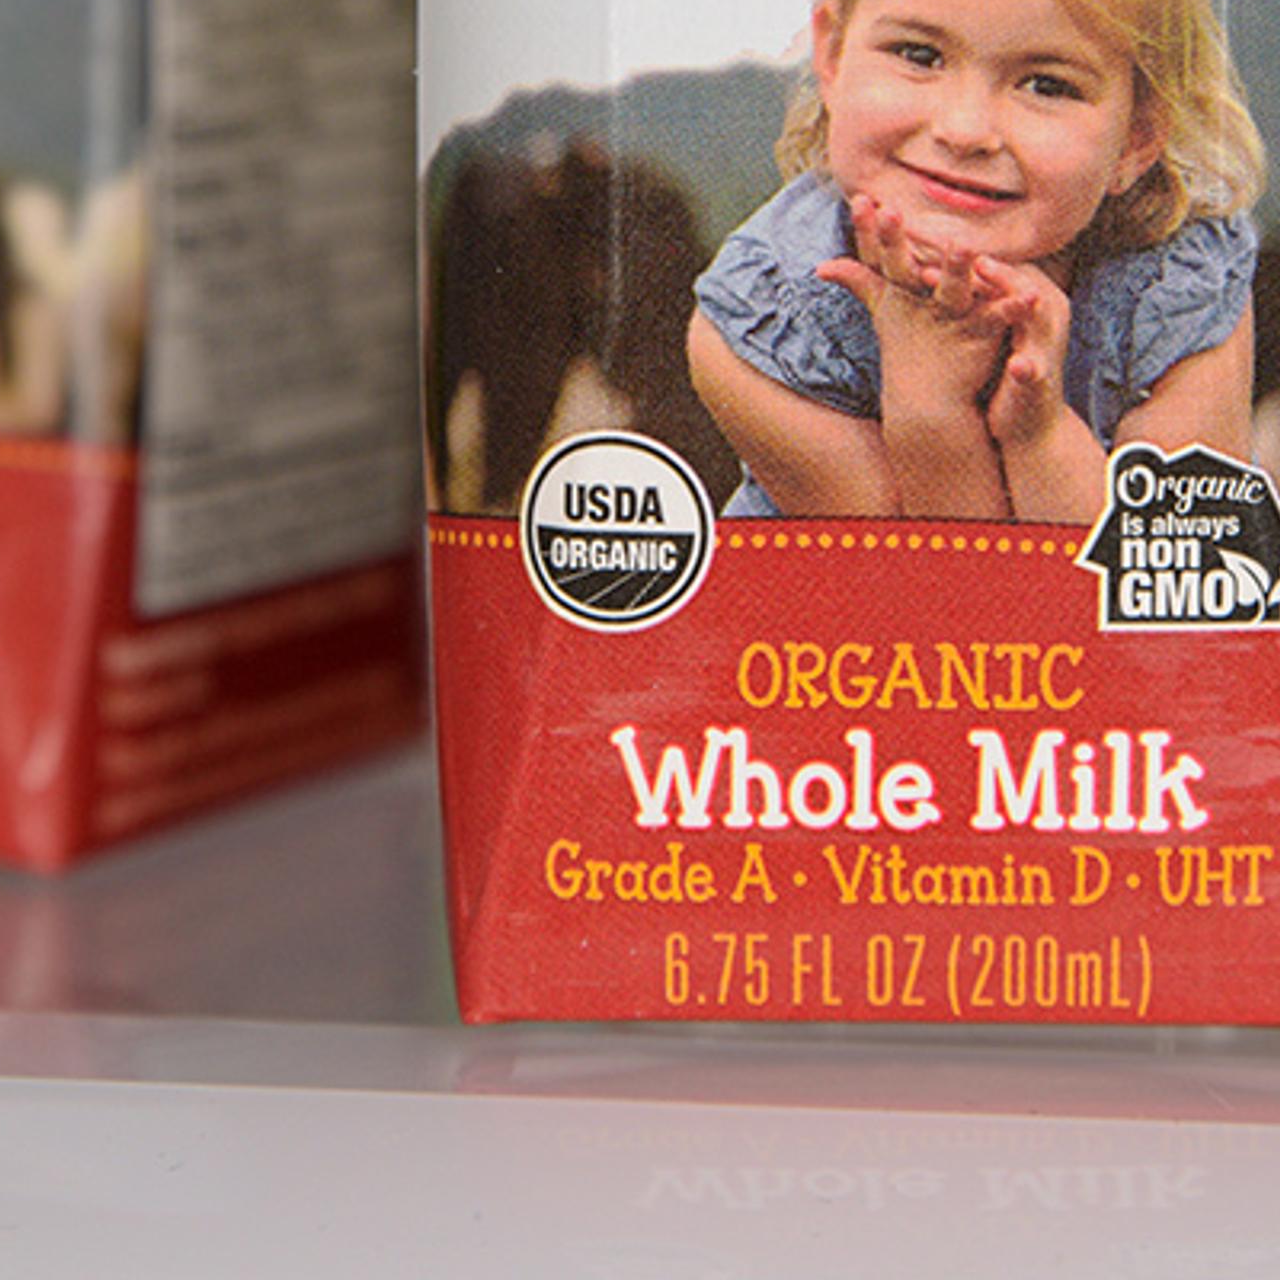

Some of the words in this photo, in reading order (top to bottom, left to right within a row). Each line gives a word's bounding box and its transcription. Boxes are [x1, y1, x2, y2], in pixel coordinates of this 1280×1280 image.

[565, 483, 663, 523] USDA
[1117, 464, 1268, 514] Organic
[1121, 511, 1144, 536] is
[1150, 511, 1241, 542] always
[550, 536, 677, 574] ORGANIC
[1121, 537, 1202, 568] non
[1120, 569, 1236, 619] GMO
[737, 641, 1085, 710] ORGANIC
[610, 725, 942, 832] Whole
[967, 729, 1210, 832] Milk
[545, 839, 718, 903] Grade
[730, 846, 778, 904] A
[822, 844, 1055, 906] Vitamin
[1070, 846, 1112, 906] D
[1156, 844, 1273, 907] UHT
[664, 931, 770, 1007] 6.75
[791, 933, 843, 1007] FL
[867, 933, 926, 1009] OZ
[946, 933, 1155, 1017] (200mL)
